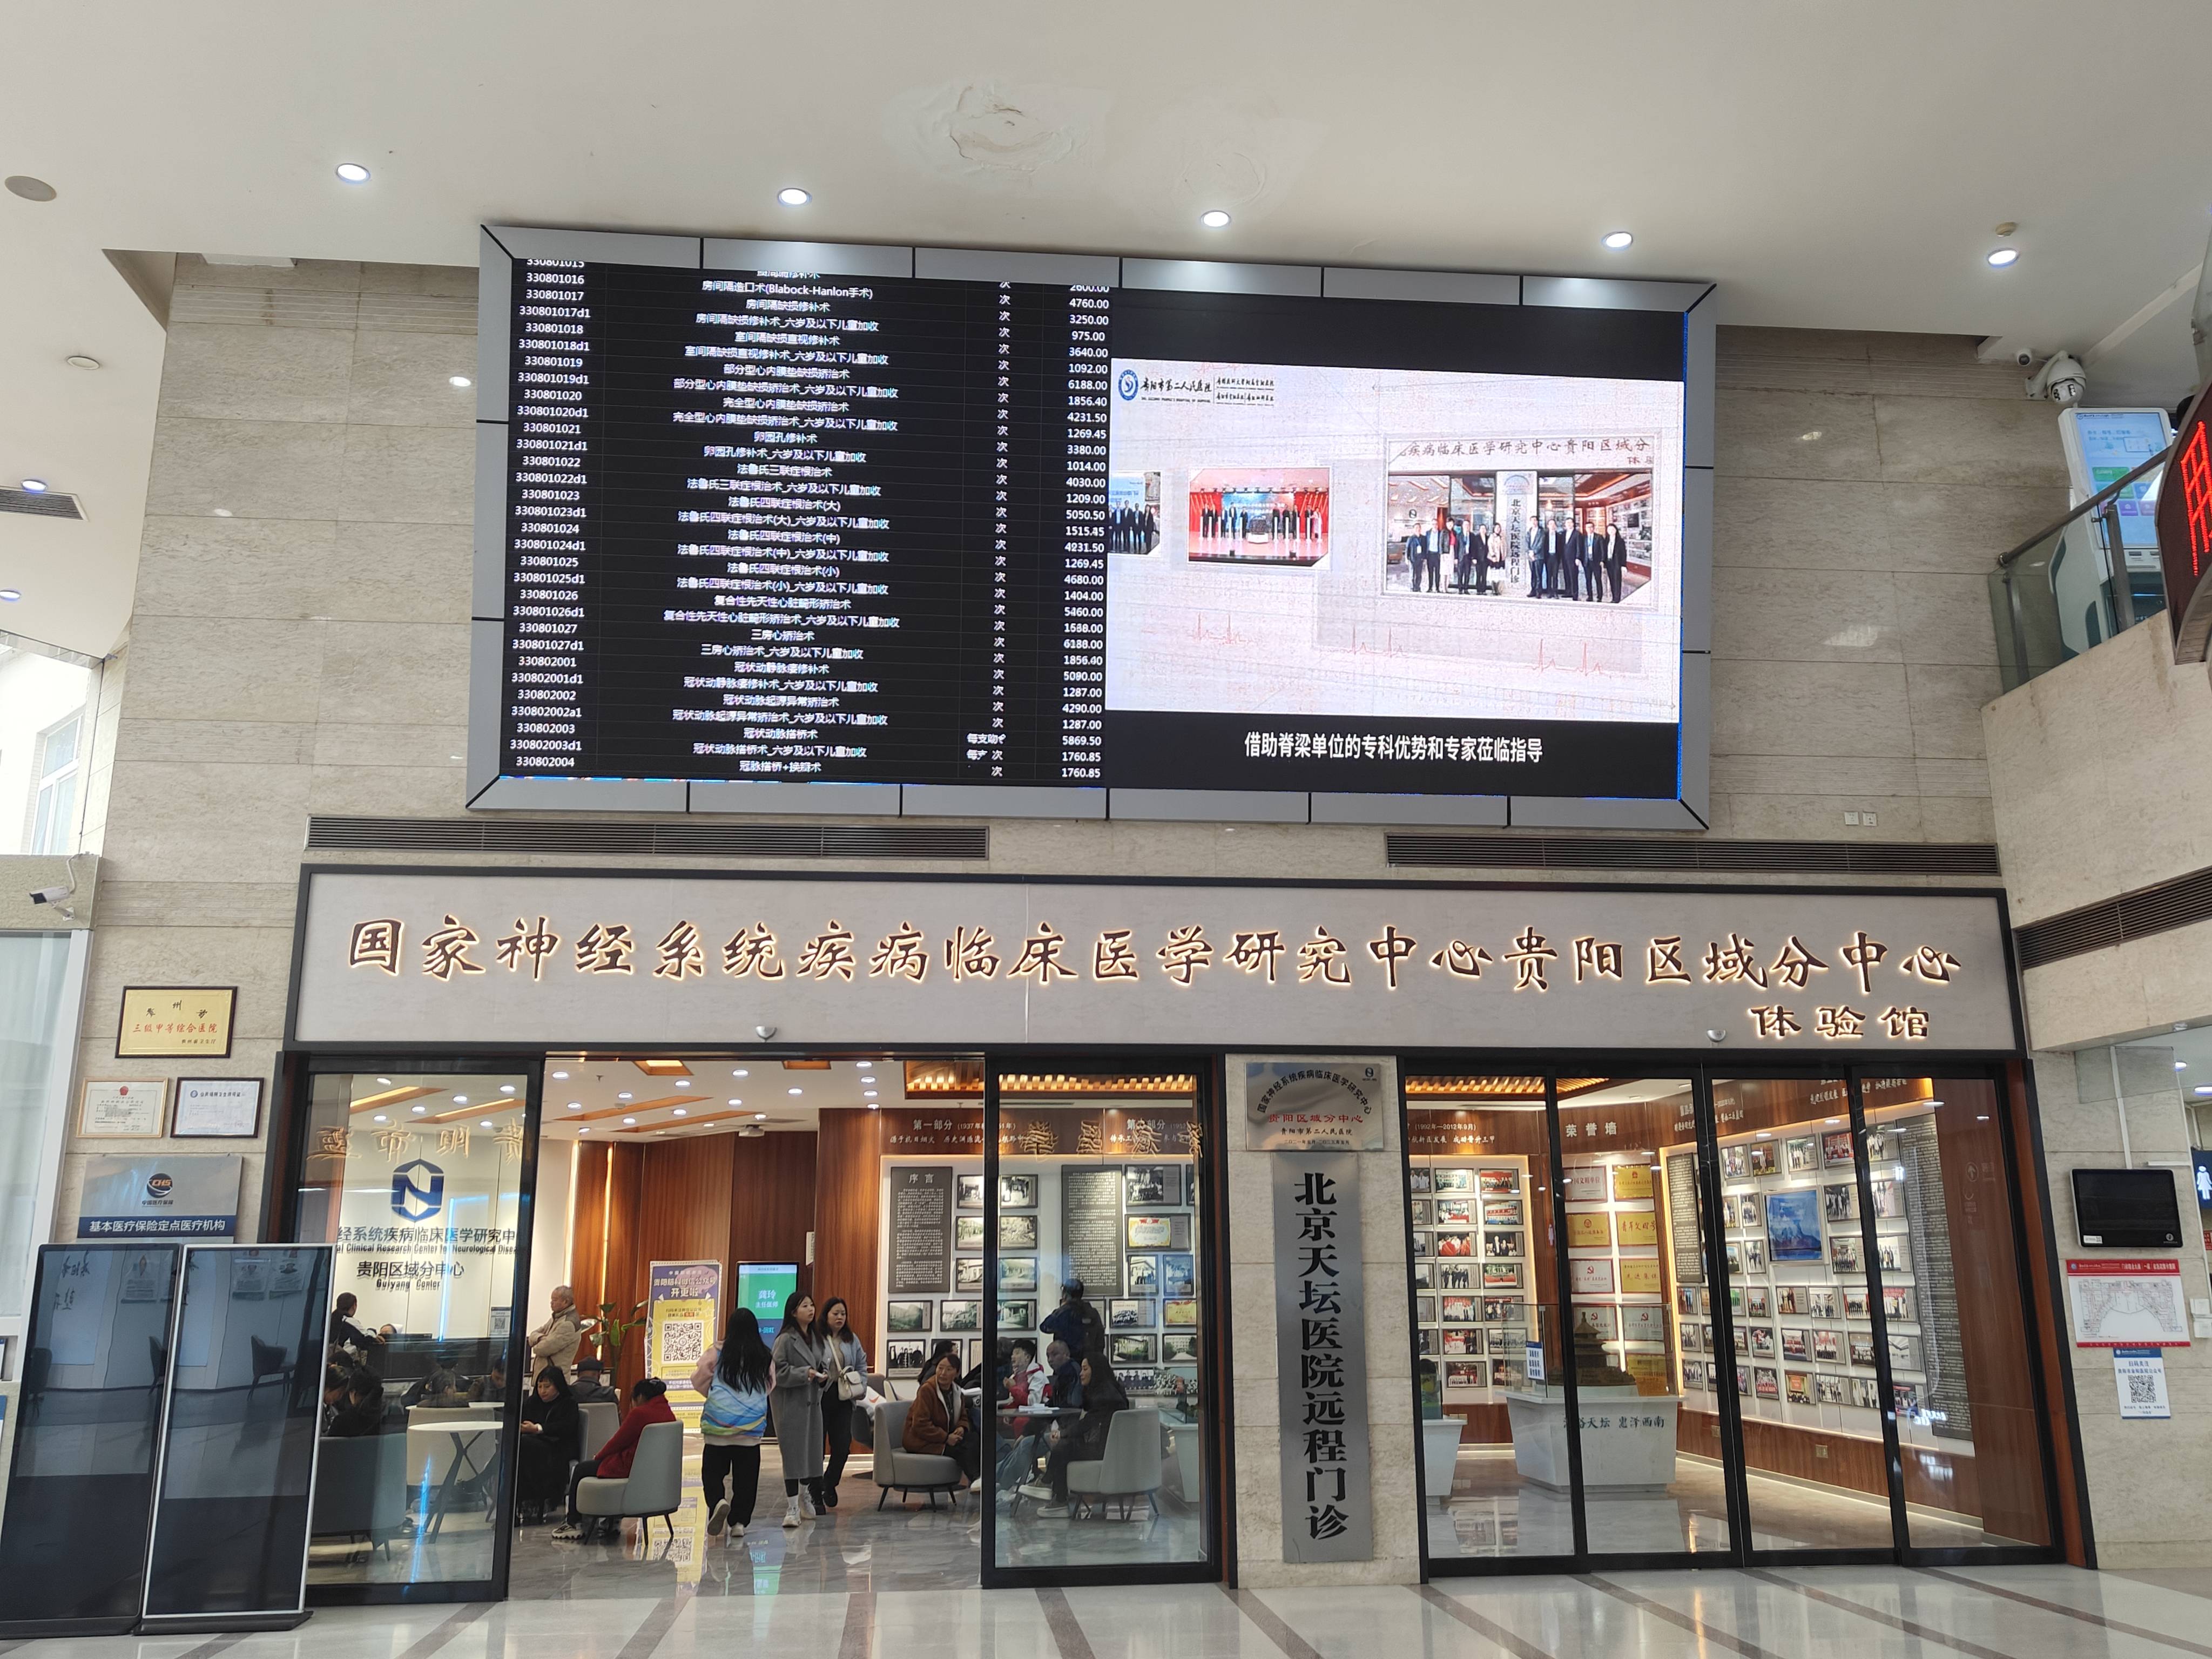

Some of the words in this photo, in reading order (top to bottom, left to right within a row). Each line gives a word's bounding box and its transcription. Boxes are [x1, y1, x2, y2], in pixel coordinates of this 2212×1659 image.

[526, 272, 584, 284] 330801016
[1069, 298, 1109, 309] 4760.00
[525, 289, 584, 300] 330801017
[999, 311, 1010, 321] 次
[1070, 315, 1109, 325] 3250.00
[520, 306, 590, 318] 330801017d1
[1072, 331, 1105, 341] 975.00
[525, 323, 583, 334] 330801018
[999, 344, 1009, 354] 次
[1069, 347, 1108, 358] 3640.00
[519, 339, 590, 351] 330801018d1
[1069, 363, 1108, 374] 1092.00
[525, 356, 583, 367] 330801019
[998, 376, 1009, 386] 次
[1068, 380, 1108, 390] 6188.00
[518, 372, 589, 384] 330801019d1
[1069, 396, 1107, 406] 1856.40
[524, 389, 582, 401] 330801020
[997, 409, 1008, 419] 次
[1067, 412, 1107, 423] 4231.50
[517, 406, 589, 417] 330801020d1
[1068, 429, 1107, 439] 1269.45
[524, 423, 581, 434] 330801021
[997, 442, 1008, 451] 次
[1068, 445, 1106, 455] 3380.00
[1400, 437, 1650, 456] 疾病临床医学研究中心贵阳区域分
[516, 439, 588, 450] 330801021d1
[1067, 461, 1105, 471] 1014.00
[523, 456, 580, 467] 330801022
[996, 475, 1007, 484] 次
[1066, 477, 1105, 488] 4030.00
[516, 473, 587, 484] 330801022d1
[1067, 494, 1105, 504] 1209.00
[515, 506, 586, 517] 330801023d1
[522, 489, 579, 500] 330801023
[996, 507, 1007, 517] 次
[1067, 510, 1105, 520] 5050.50
[521, 523, 579, 534] 330801024
[995, 539, 1006, 550] 次
[1064, 542, 1104, 552] 4231.50
[1509, 498, 1522, 585] 北京天坛医院远程门诊
[515, 539, 586, 551] 330801024d1
[1065, 558, 1103, 569] 1269.45
[521, 556, 578, 567] 330801025
[995, 572, 1006, 582] 次
[1064, 575, 1103, 585] 4680.00
[514, 572, 585, 584] 330801025d1
[1065, 591, 1103, 601] 1404.00
[513, 606, 584, 617] 330801026d1
[520, 589, 578, 600] 330801026
[994, 604, 1005, 615] 次
[512, 639, 584, 651] 330801027d1
[519, 623, 577, 633] 330801027
[994, 637, 1004, 647] 次
[518, 656, 577, 667] 330802001
[993, 669, 1004, 679] 次
[512, 673, 583, 684] 330802001d1
[1063, 687, 1102, 697] 1287.00
[518, 690, 576, 700] 330802002
[993, 702, 1003, 711] 次
[1062, 704, 1102, 713] 4290.00
[511, 706, 582, 717] 330802002a1
[1063, 720, 1102, 730] 1287.00
[517, 723, 575, 734] 330802003
[1063, 736, 1101, 745] 5869.50
[1245, 731, 1543, 763] 借助脊梁单位的专科优势和专家莅临指导
[510, 739, 582, 751] 330802003d1
[992, 750, 1003, 760] 次
[1062, 752, 1101, 761] 1760.85
[516, 757, 575, 767] 330802004
[991, 766, 1002, 776] 次
[1062, 768, 1100, 778] 1760.85
[349, 915, 1960, 993] 国家神经系统疾病临床医学研究中心贵阳区域分中心
[133, 1023, 218, 1034] 三级甲等综合医院
[1750, 1005, 1930, 1040] 体验馆
[1257, 1069, 1372, 1115] 国家神经系统疾病临床医学研究中心
[913, 1120, 953, 1130] 第一部分
[1269, 1114, 1363, 1124] 贵阳区域分中心
[1281, 1127, 1352, 1135] 贵阳市第二人民医院
[1565, 1121, 1617, 1137] 荣誉墙
[909, 1174, 934, 1184] 序言
[89, 1220, 225, 1232] 基本医疗保险定点医疗机构
[346, 1244, 374, 1253] Clinical
[376, 1244, 411, 1253] Research
[414, 1244, 437, 1253] Center
[453, 1245, 496, 1254] Neurological
[357, 1261, 464, 1278] 贵阳区域分中心
[376, 1279, 410, 1291] Guiyang
[416, 1279, 441, 1289] Center
[671, 1287, 699, 1297] 开更啦
[1294, 1172, 1349, 1540] 北京天坛医院远程门诊
